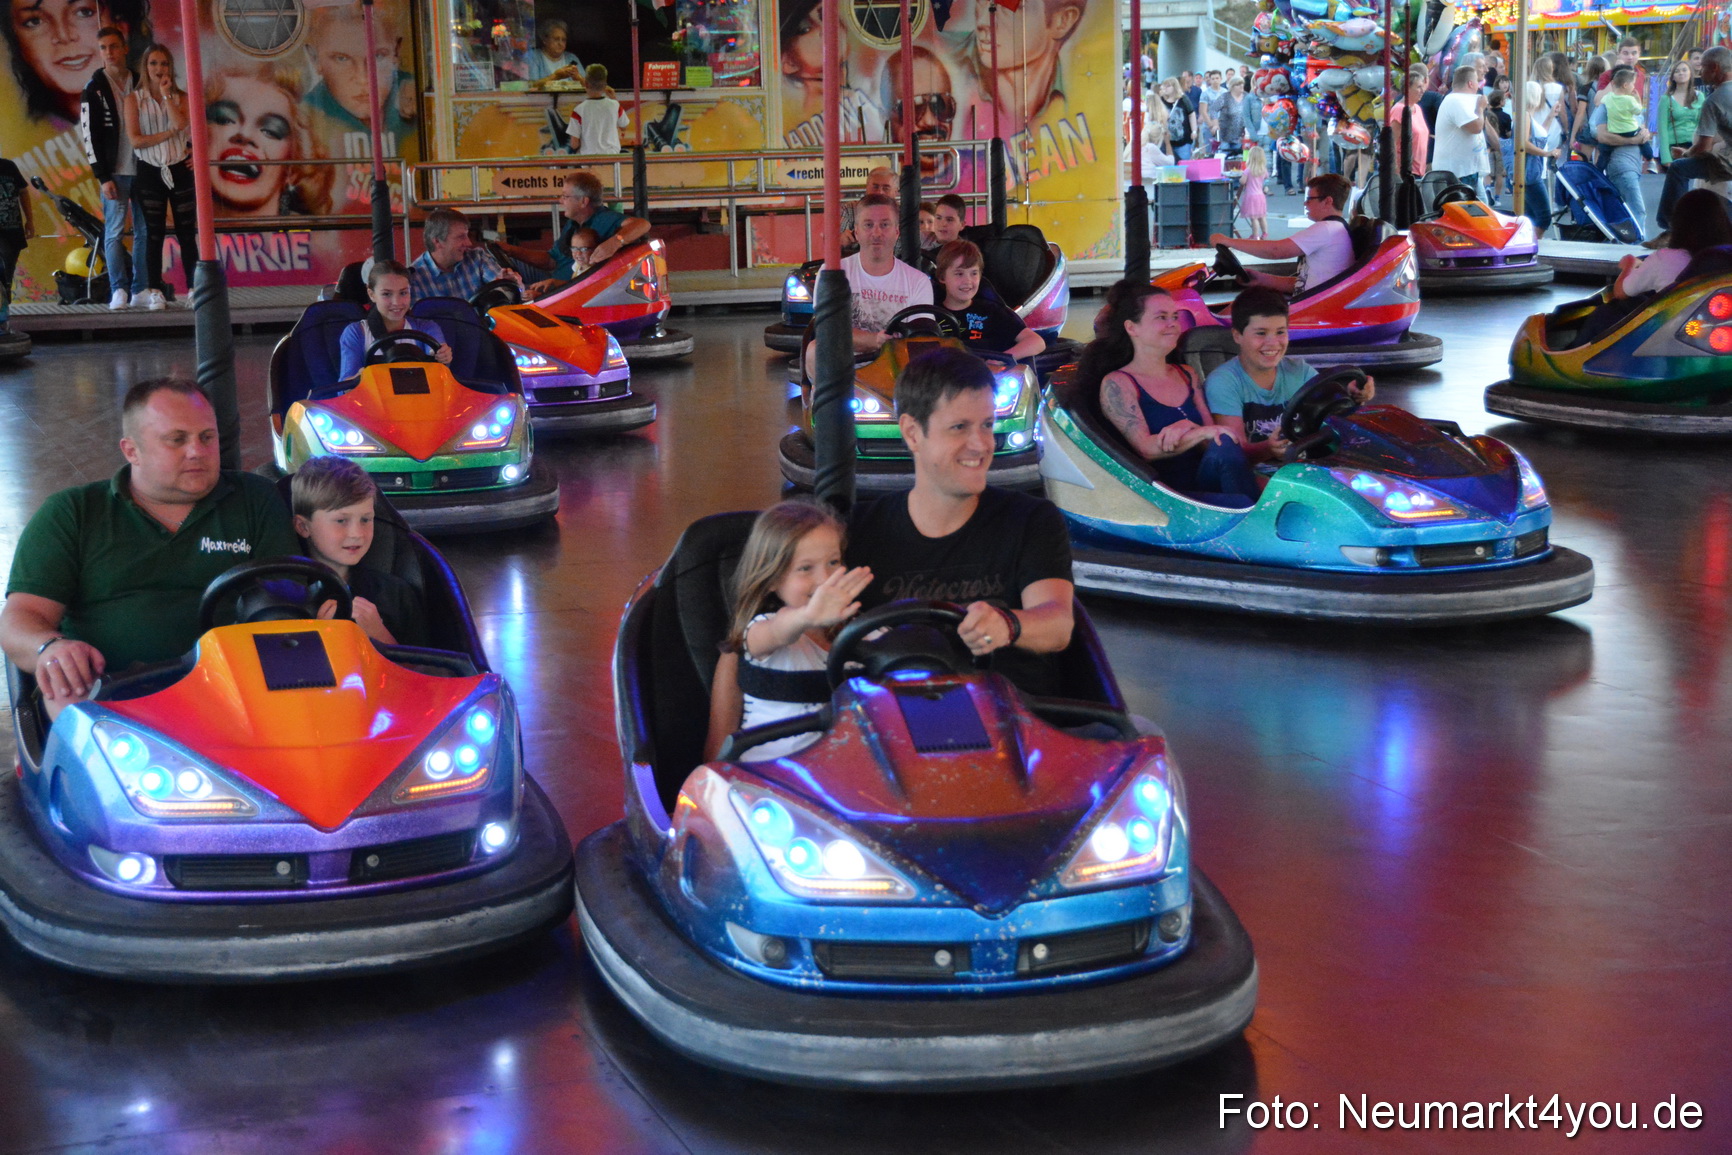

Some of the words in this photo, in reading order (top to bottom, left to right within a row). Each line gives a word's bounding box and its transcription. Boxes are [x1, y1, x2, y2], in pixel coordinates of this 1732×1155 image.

[648, 63, 676, 71] Fahrpreis
[796, 167, 825, 180] recht
[839, 166, 869, 179] ahren
[511, 176, 548, 189] rechts
[861, 288, 909, 304] Wilderer
